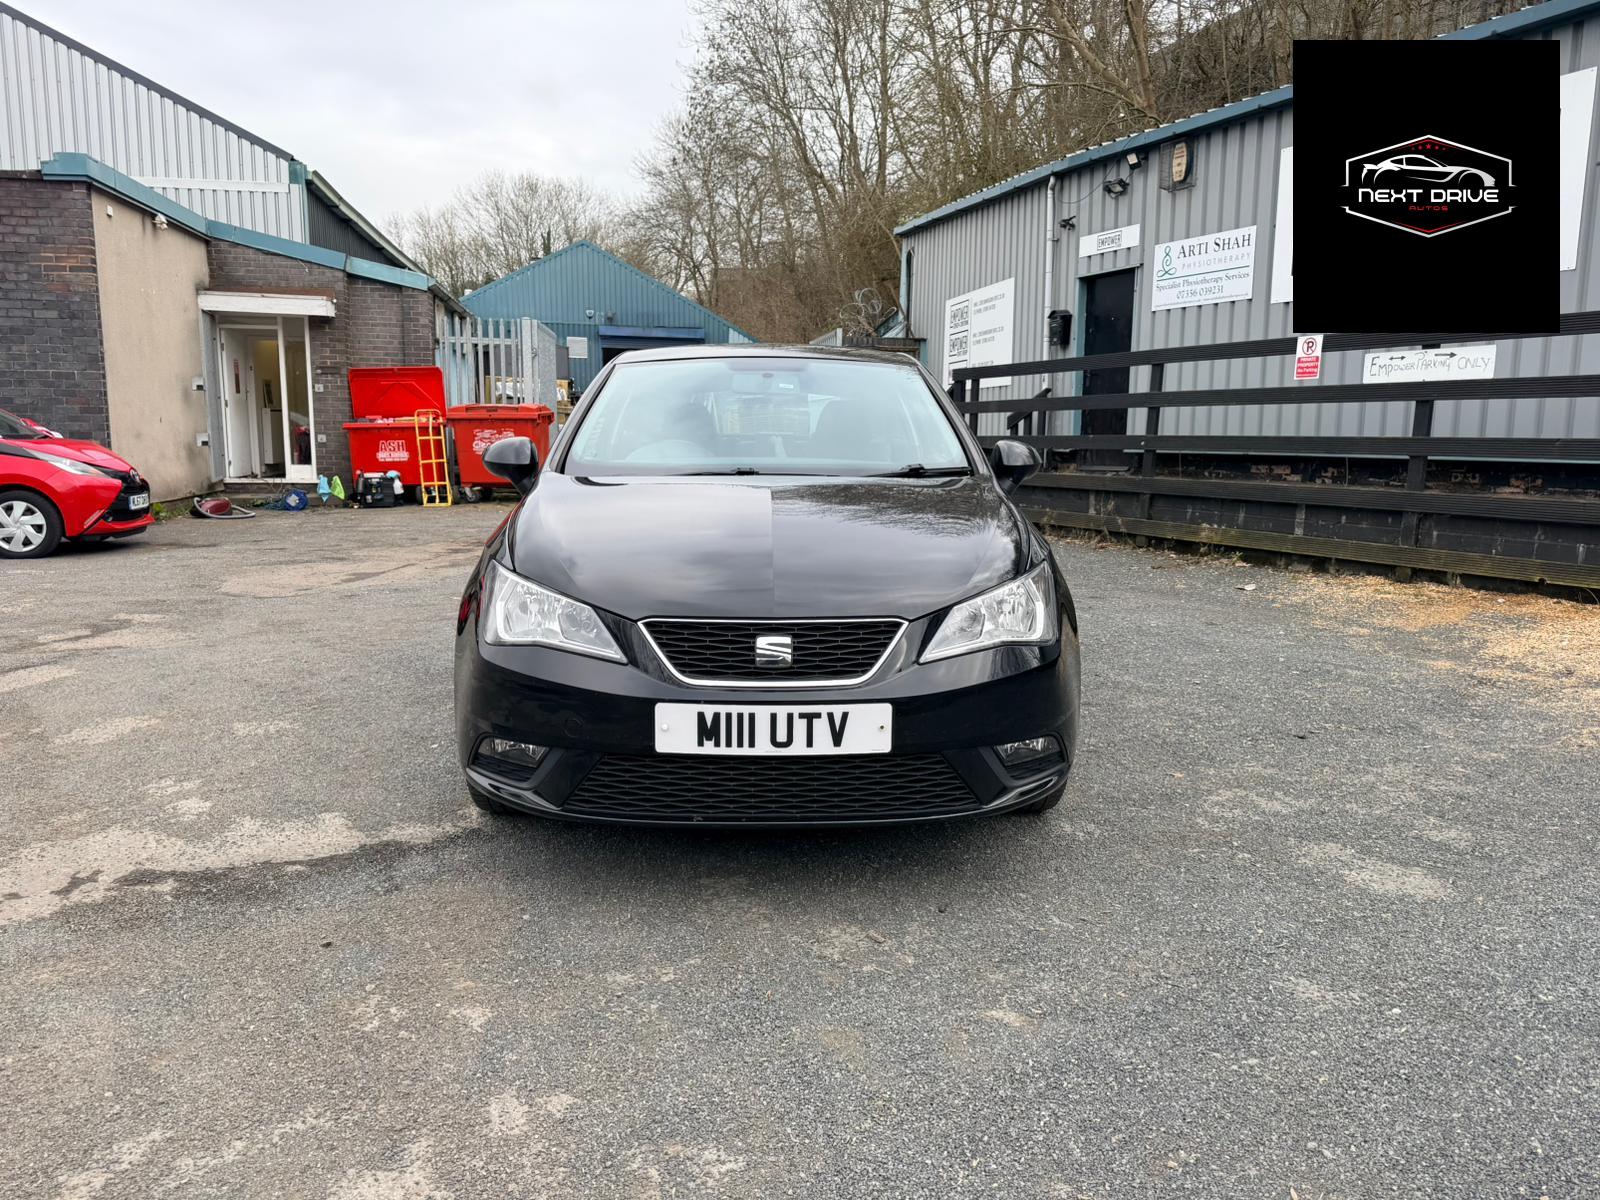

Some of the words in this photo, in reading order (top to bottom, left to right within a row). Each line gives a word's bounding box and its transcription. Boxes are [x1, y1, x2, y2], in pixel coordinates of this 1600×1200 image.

[1177, 241, 1209, 259] ARTI
[1213, 233, 1251, 253] SHAH
[1182, 252, 1251, 270] PHYSIOTHERAPY
[1182, 275, 1224, 288] Physiotherapy
[1224, 270, 1250, 281] Services
[1457, 356, 1491, 372] ONLY
[379, 440, 406, 452] ASH
[697, 711, 756, 748] M111
[770, 711, 850, 748] UTV
